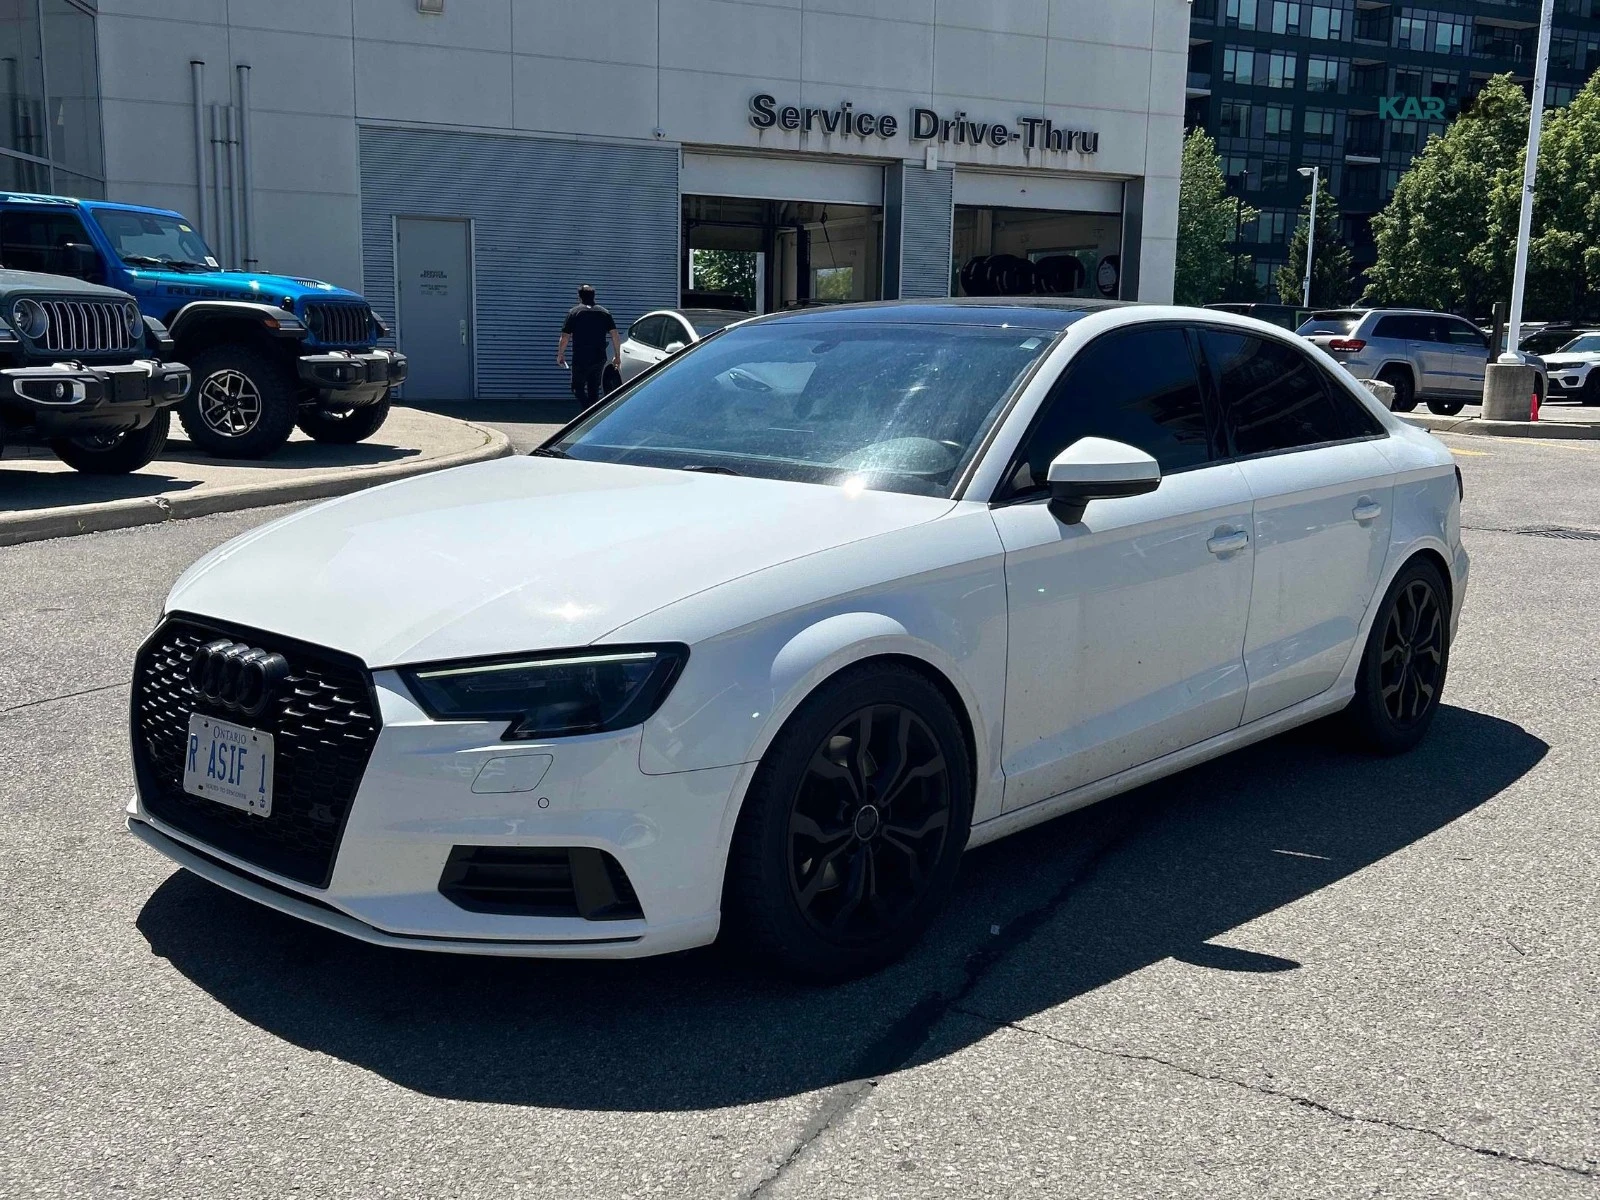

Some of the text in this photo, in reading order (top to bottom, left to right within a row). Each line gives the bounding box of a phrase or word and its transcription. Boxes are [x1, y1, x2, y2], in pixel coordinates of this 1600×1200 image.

[750, 93, 1100, 154] Service Drive-Thru
[167, 285, 274, 302] RUBICON
[188, 735, 266, 793] R ASIF 1
